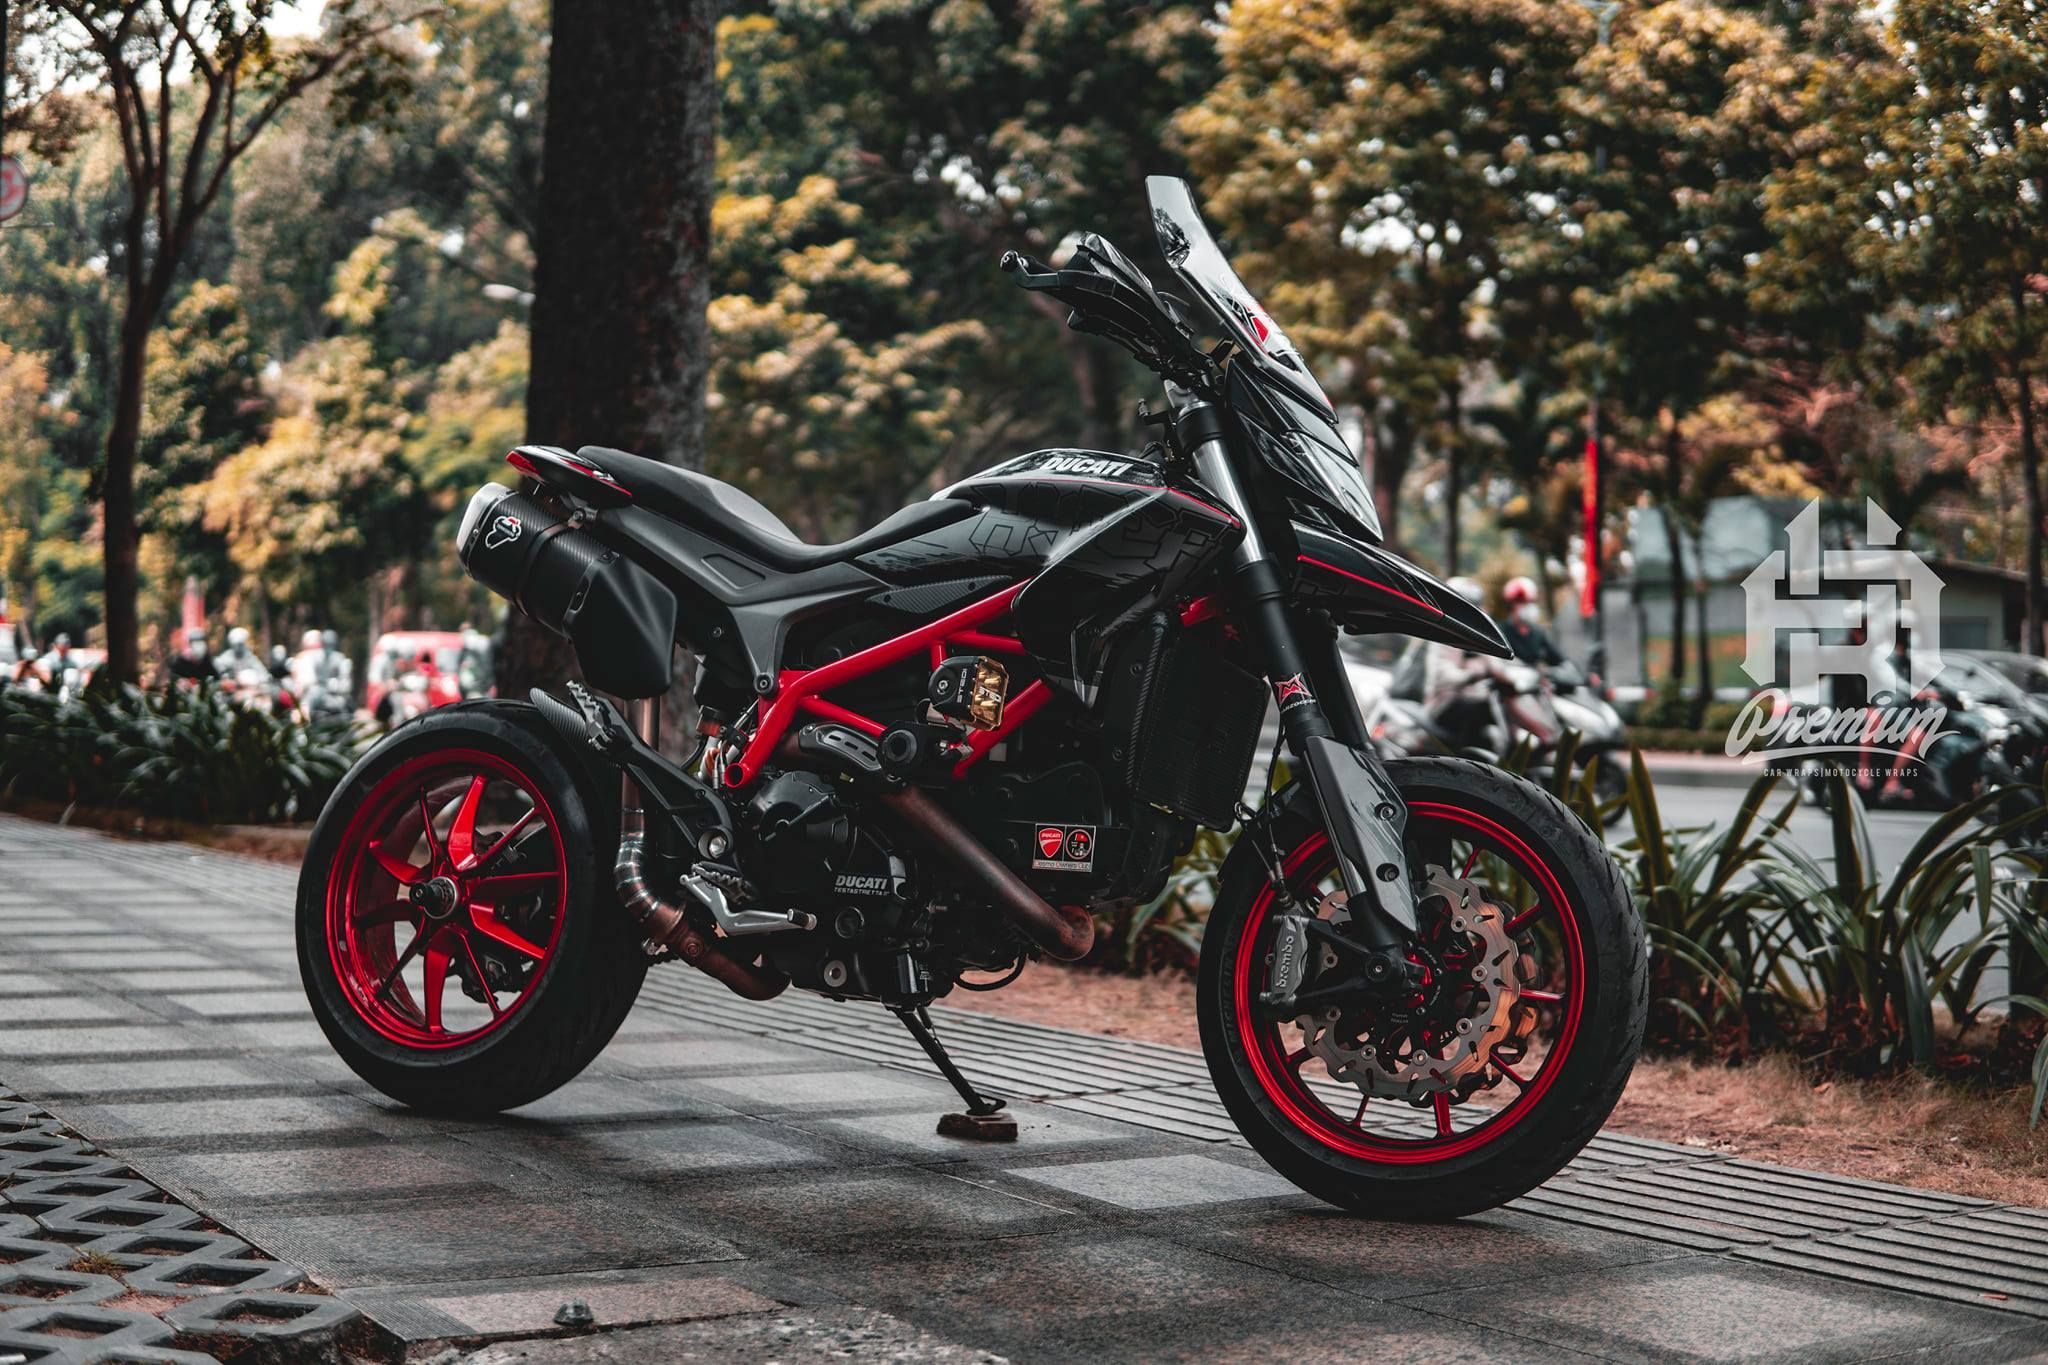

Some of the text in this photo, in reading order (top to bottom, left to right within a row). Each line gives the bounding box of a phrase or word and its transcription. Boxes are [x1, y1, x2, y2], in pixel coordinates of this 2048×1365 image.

[1042, 457, 1134, 476] DUCATI
[956, 668, 967, 703] STEDI
[835, 875, 888, 890] DUCATI
[1275, 935, 1294, 988] brembo
